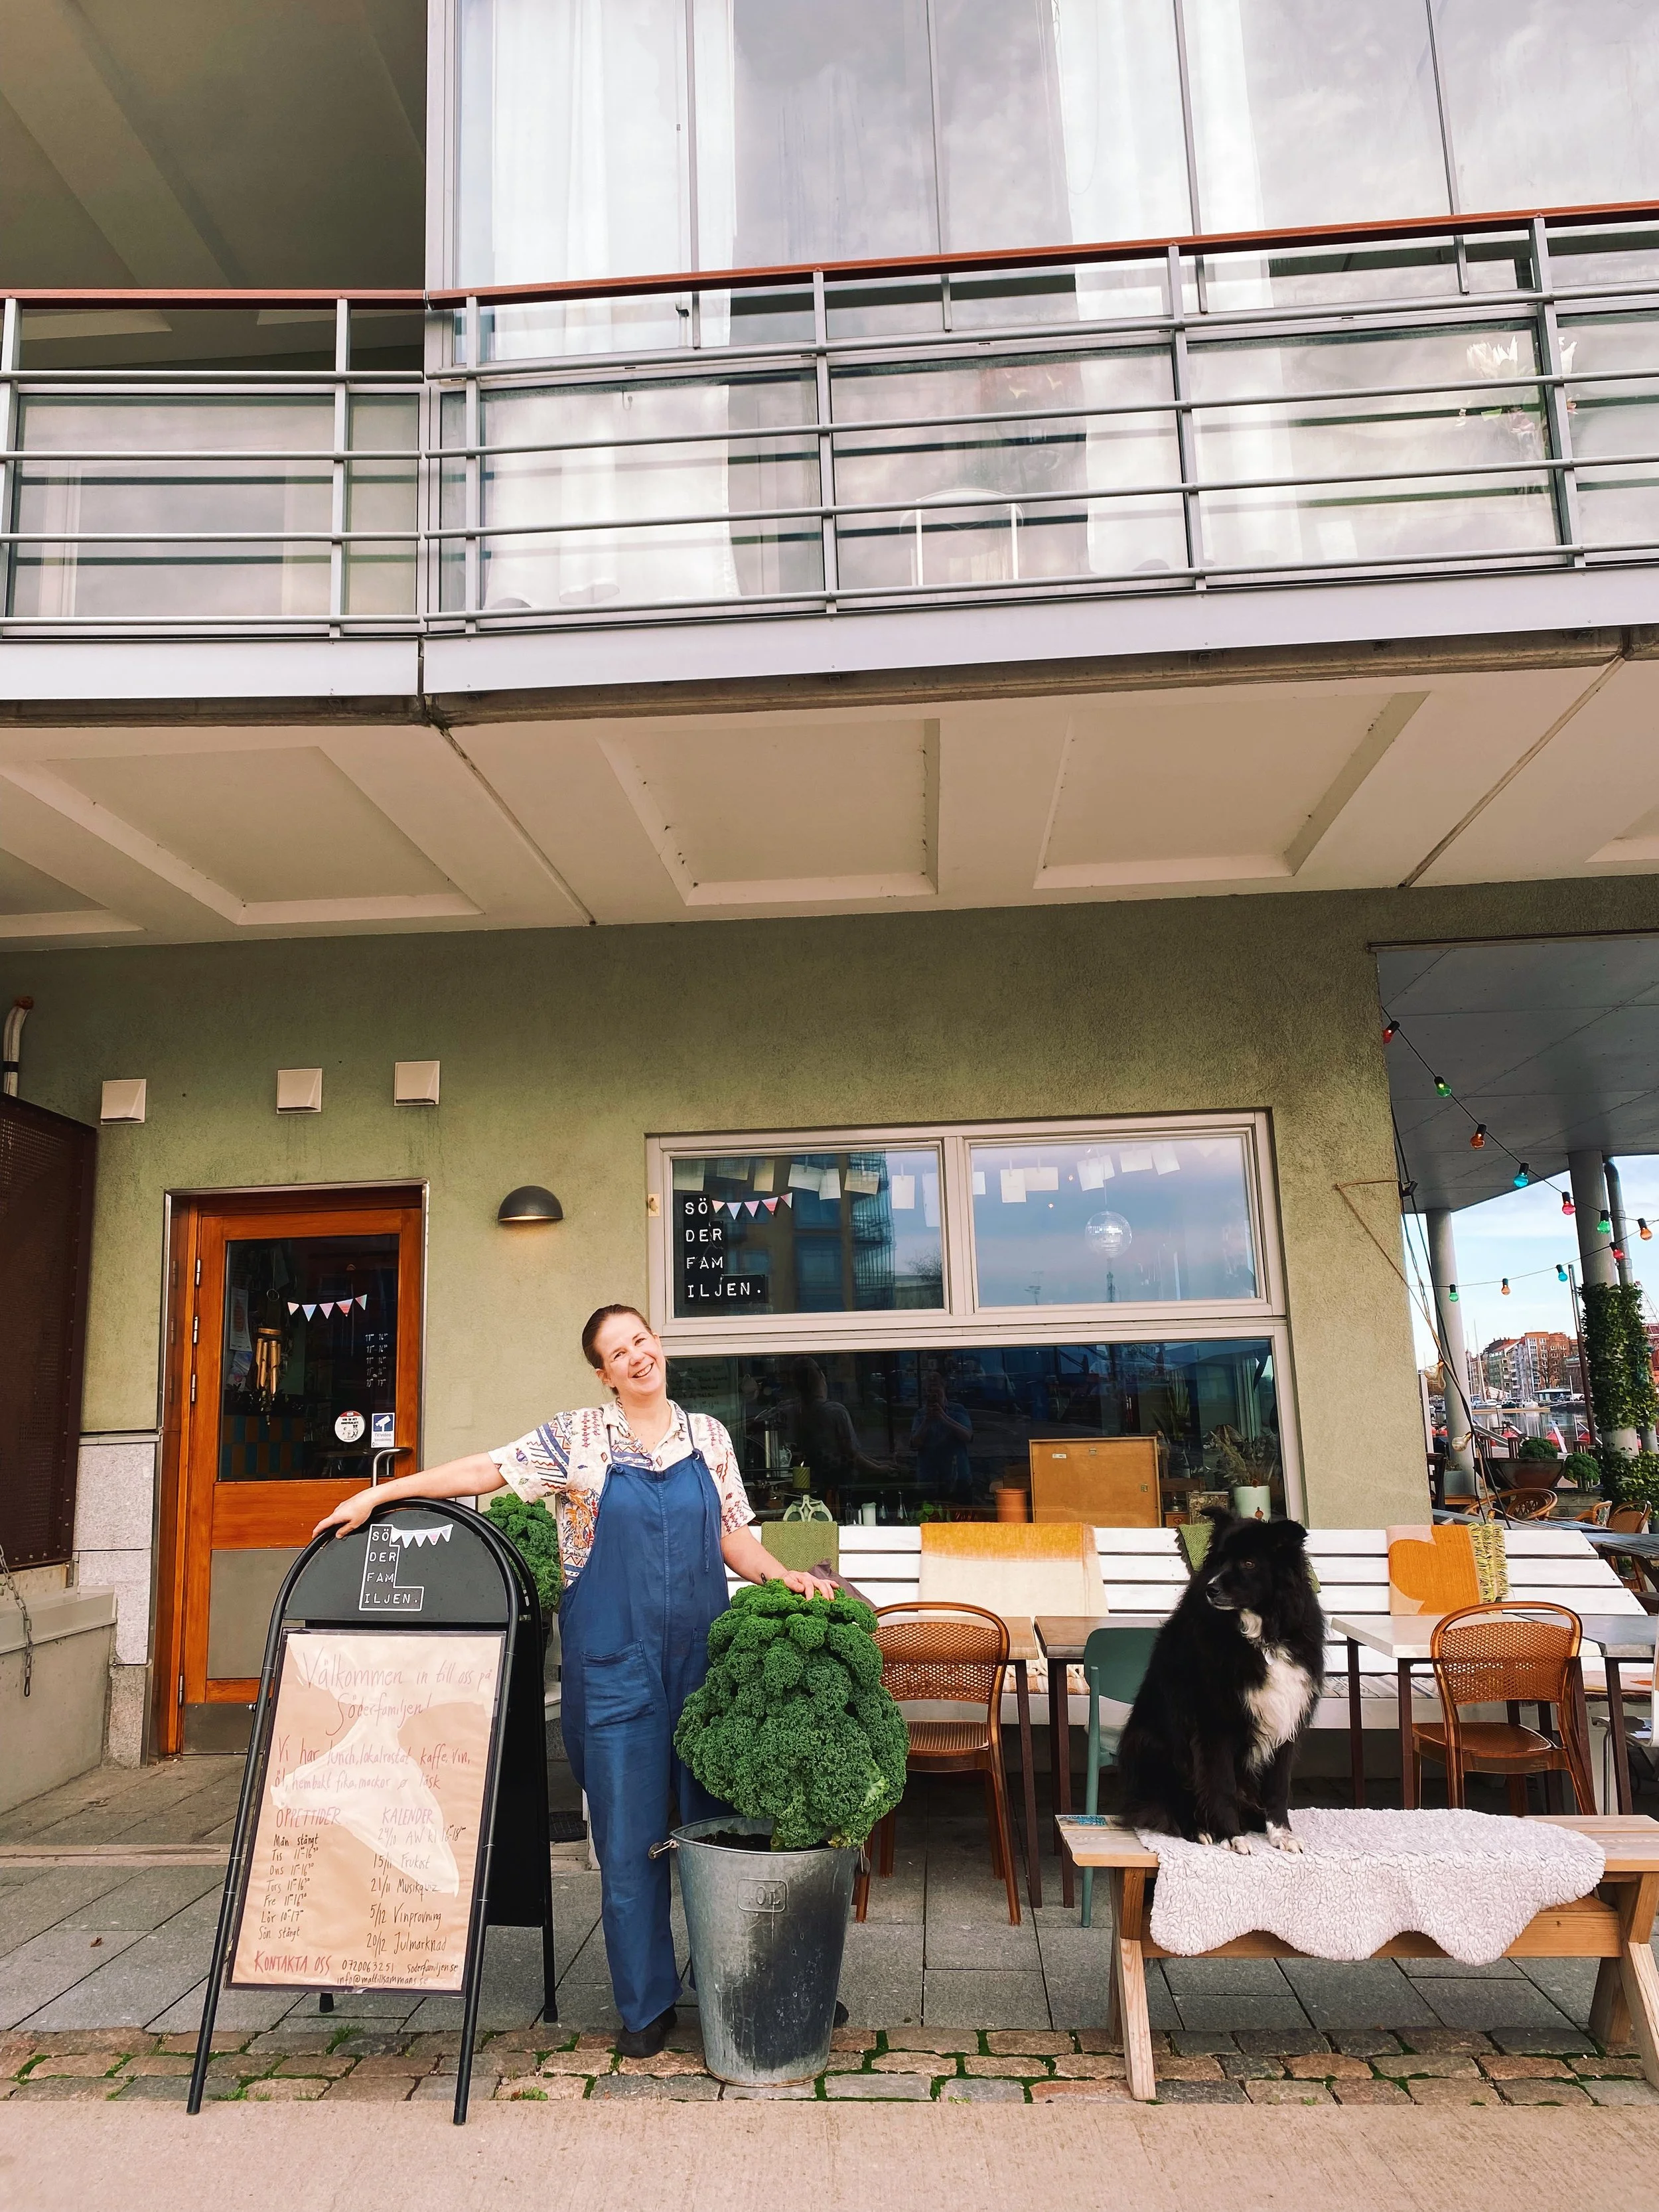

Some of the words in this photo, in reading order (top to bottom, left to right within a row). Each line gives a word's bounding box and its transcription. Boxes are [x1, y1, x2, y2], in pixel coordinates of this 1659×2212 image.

[685, 1197, 708, 1215] SÖ
[685, 1228, 723, 1242] DER
[686, 1256, 723, 1270] FAM
[687, 1282, 761, 1298] ILJEN.
[372, 1528, 390, 1542] SÖ
[369, 1552, 397, 1562] DER
[366, 1572, 394, 1583] FAM
[364, 1593, 418, 1604] ILJEN.
[303, 1646, 404, 1689] Välkommen
[417, 1667, 427, 1684] in
[436, 1660, 457, 1684] till
[458, 1670, 474, 1685] oss
[477, 1668, 493, 1692] på
[279, 1735, 290, 1763] Vi
[299, 1737, 320, 1765] har
[327, 1739, 358, 1765] lunch,
[276, 1803, 341, 1828] ÖPPETTIDER
[382, 1806, 435, 1826] KALENDER
[273, 1834, 289, 1847] Mån
[378, 1827, 397, 1848] 24/10
[405, 1826, 425, 1846] AW
[272, 1848, 283, 1862] Tis
[269, 1865, 284, 1876] Ons
[373, 1851, 392, 1876] 15/11
[401, 1851, 431, 1870] Frukost
[266, 1879, 281, 1894] Tors
[370, 1875, 391, 1899] 21/11
[397, 1878, 441, 1902] Musikquiz
[263, 1893, 276, 1907] Fre
[370, 1902, 387, 1928] 5/12
[394, 1902, 442, 1931] Vinprovning
[366, 1931, 388, 1958] 20/12
[394, 1931, 447, 1954] Julmarknad
[254, 1950, 308, 1974] KONTAKTA
[314, 1954, 332, 1976] OSS
[342, 1959, 394, 1974] 0720063251
